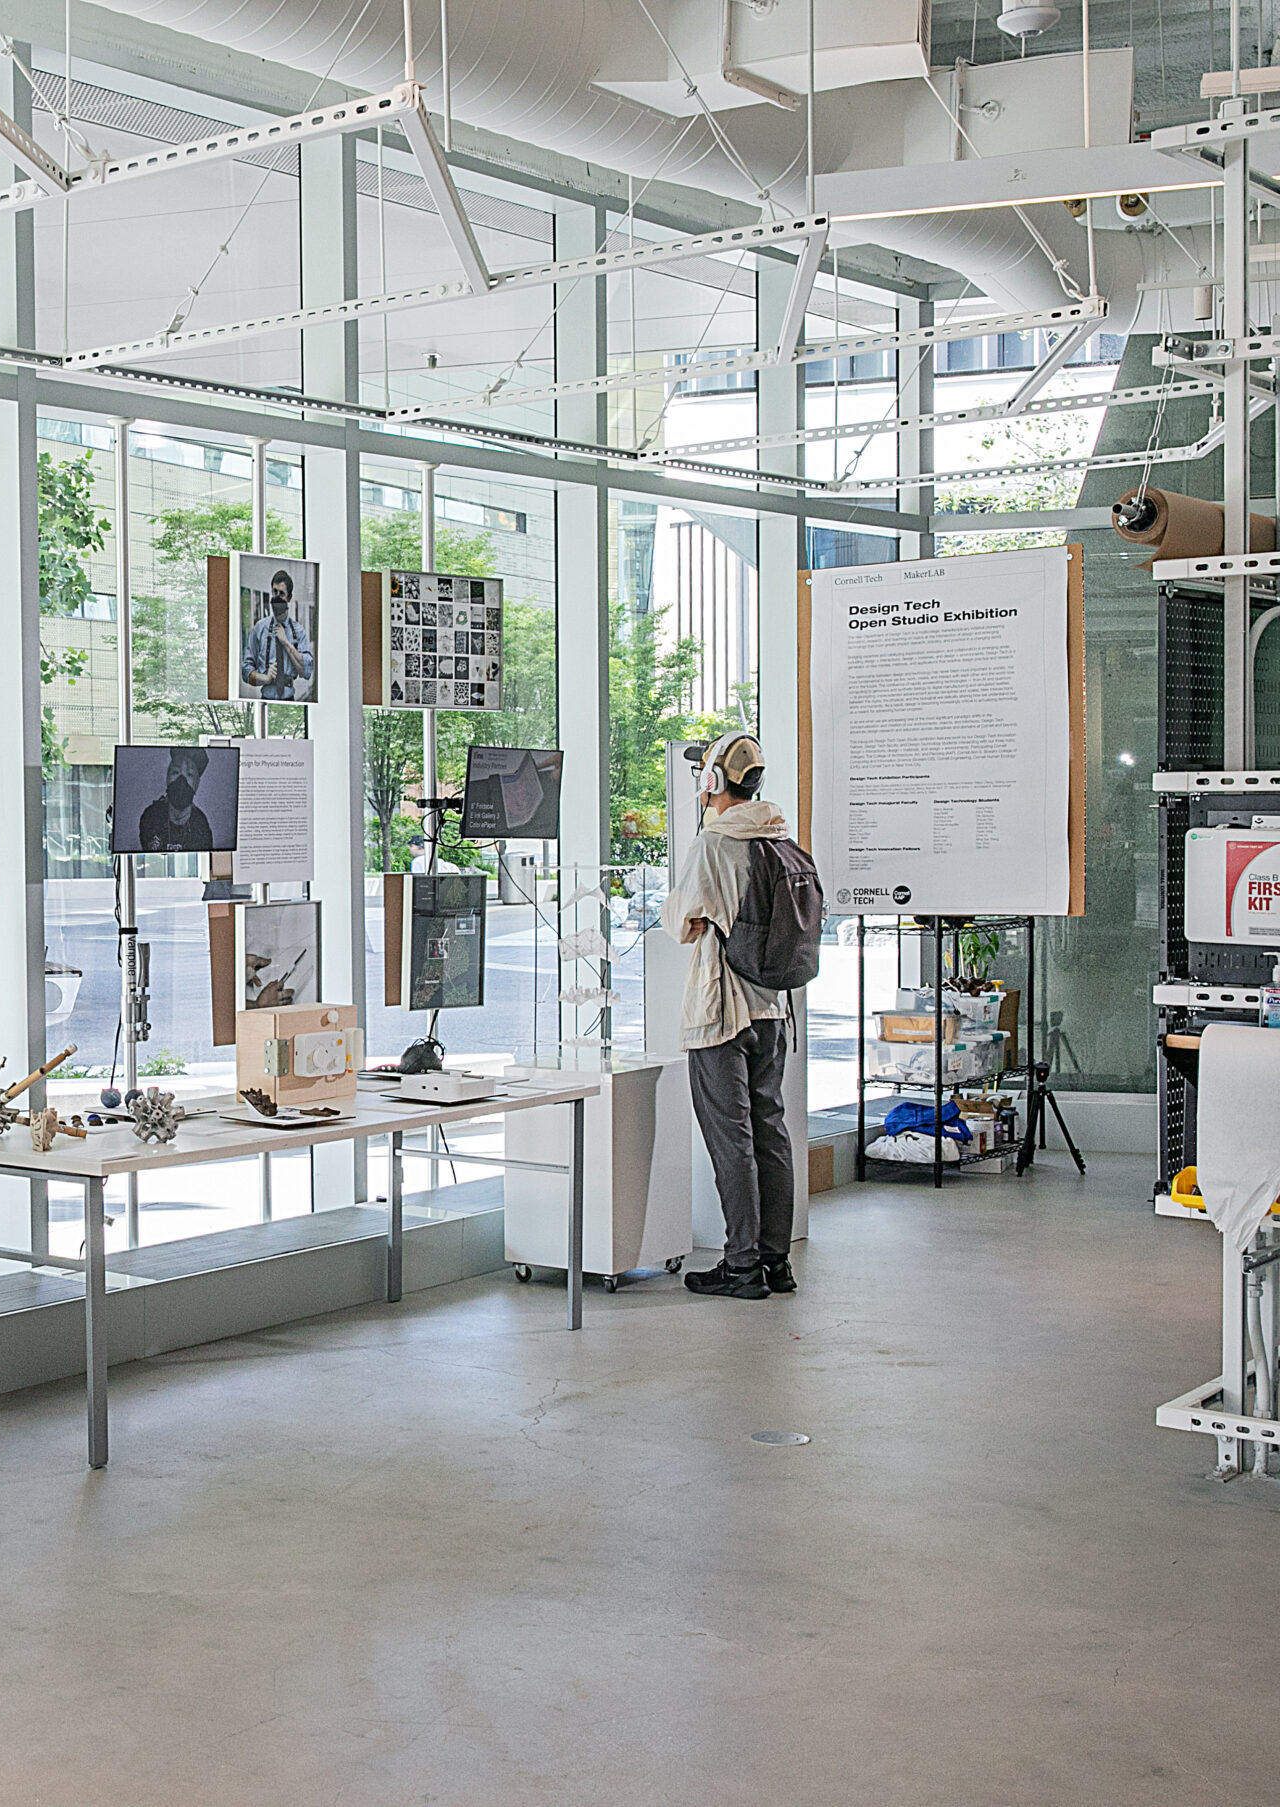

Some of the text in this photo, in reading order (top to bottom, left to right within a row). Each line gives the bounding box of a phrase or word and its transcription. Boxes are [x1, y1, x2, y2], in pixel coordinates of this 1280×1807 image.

[834, 574, 882, 586] Cornell Tech
[904, 568, 945, 580] MakerLAB
[849, 599, 940, 616] Design Tech
[848, 608, 1018, 630] Open Studio Exhibition
[261, 760, 279, 768] Physical
[1248, 873, 1270, 881] Class
[853, 888, 890, 896] CORNELL
[1248, 897, 1272, 910] KIT
